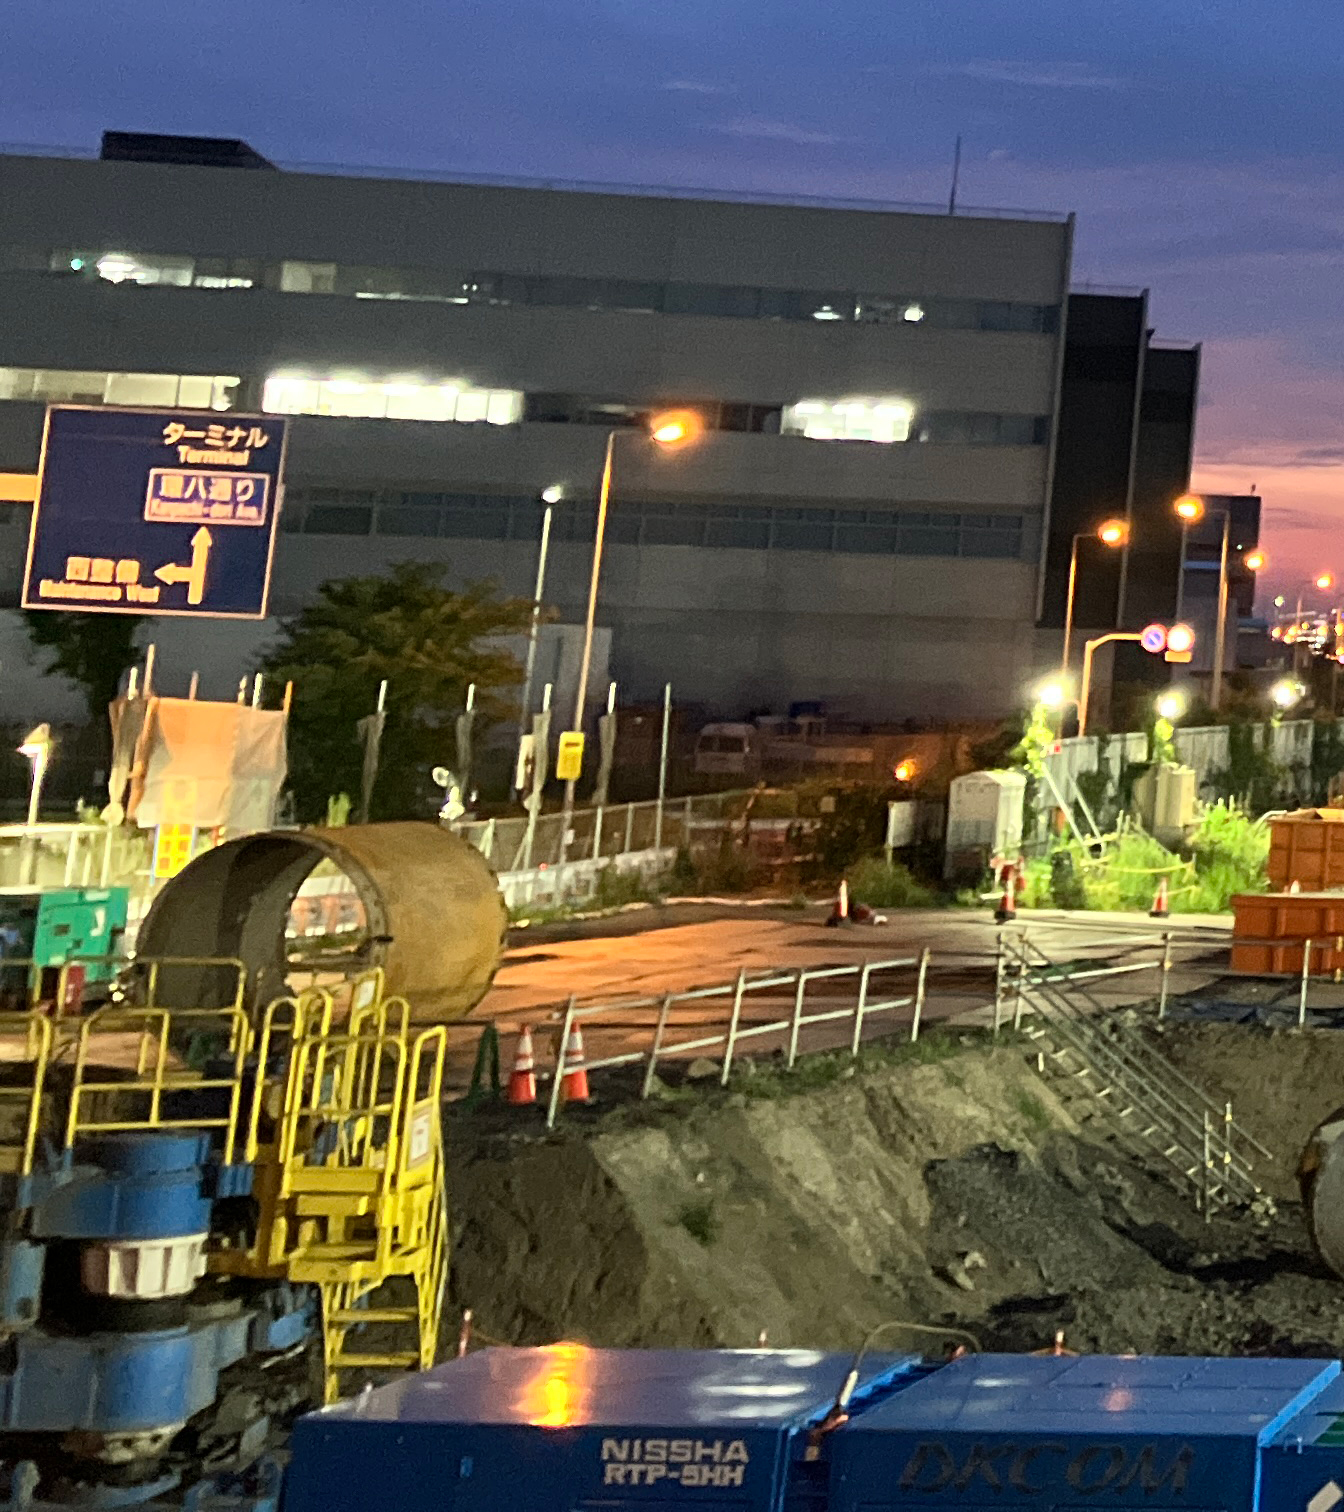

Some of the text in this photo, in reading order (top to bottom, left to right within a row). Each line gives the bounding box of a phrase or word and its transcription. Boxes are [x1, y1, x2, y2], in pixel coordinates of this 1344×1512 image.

[162, 421, 269, 448] ターミナル
[177, 445, 250, 466] Terminal
[601, 1438, 750, 1464] NISSHA
[896, 1439, 1196, 1496] DKCOM
